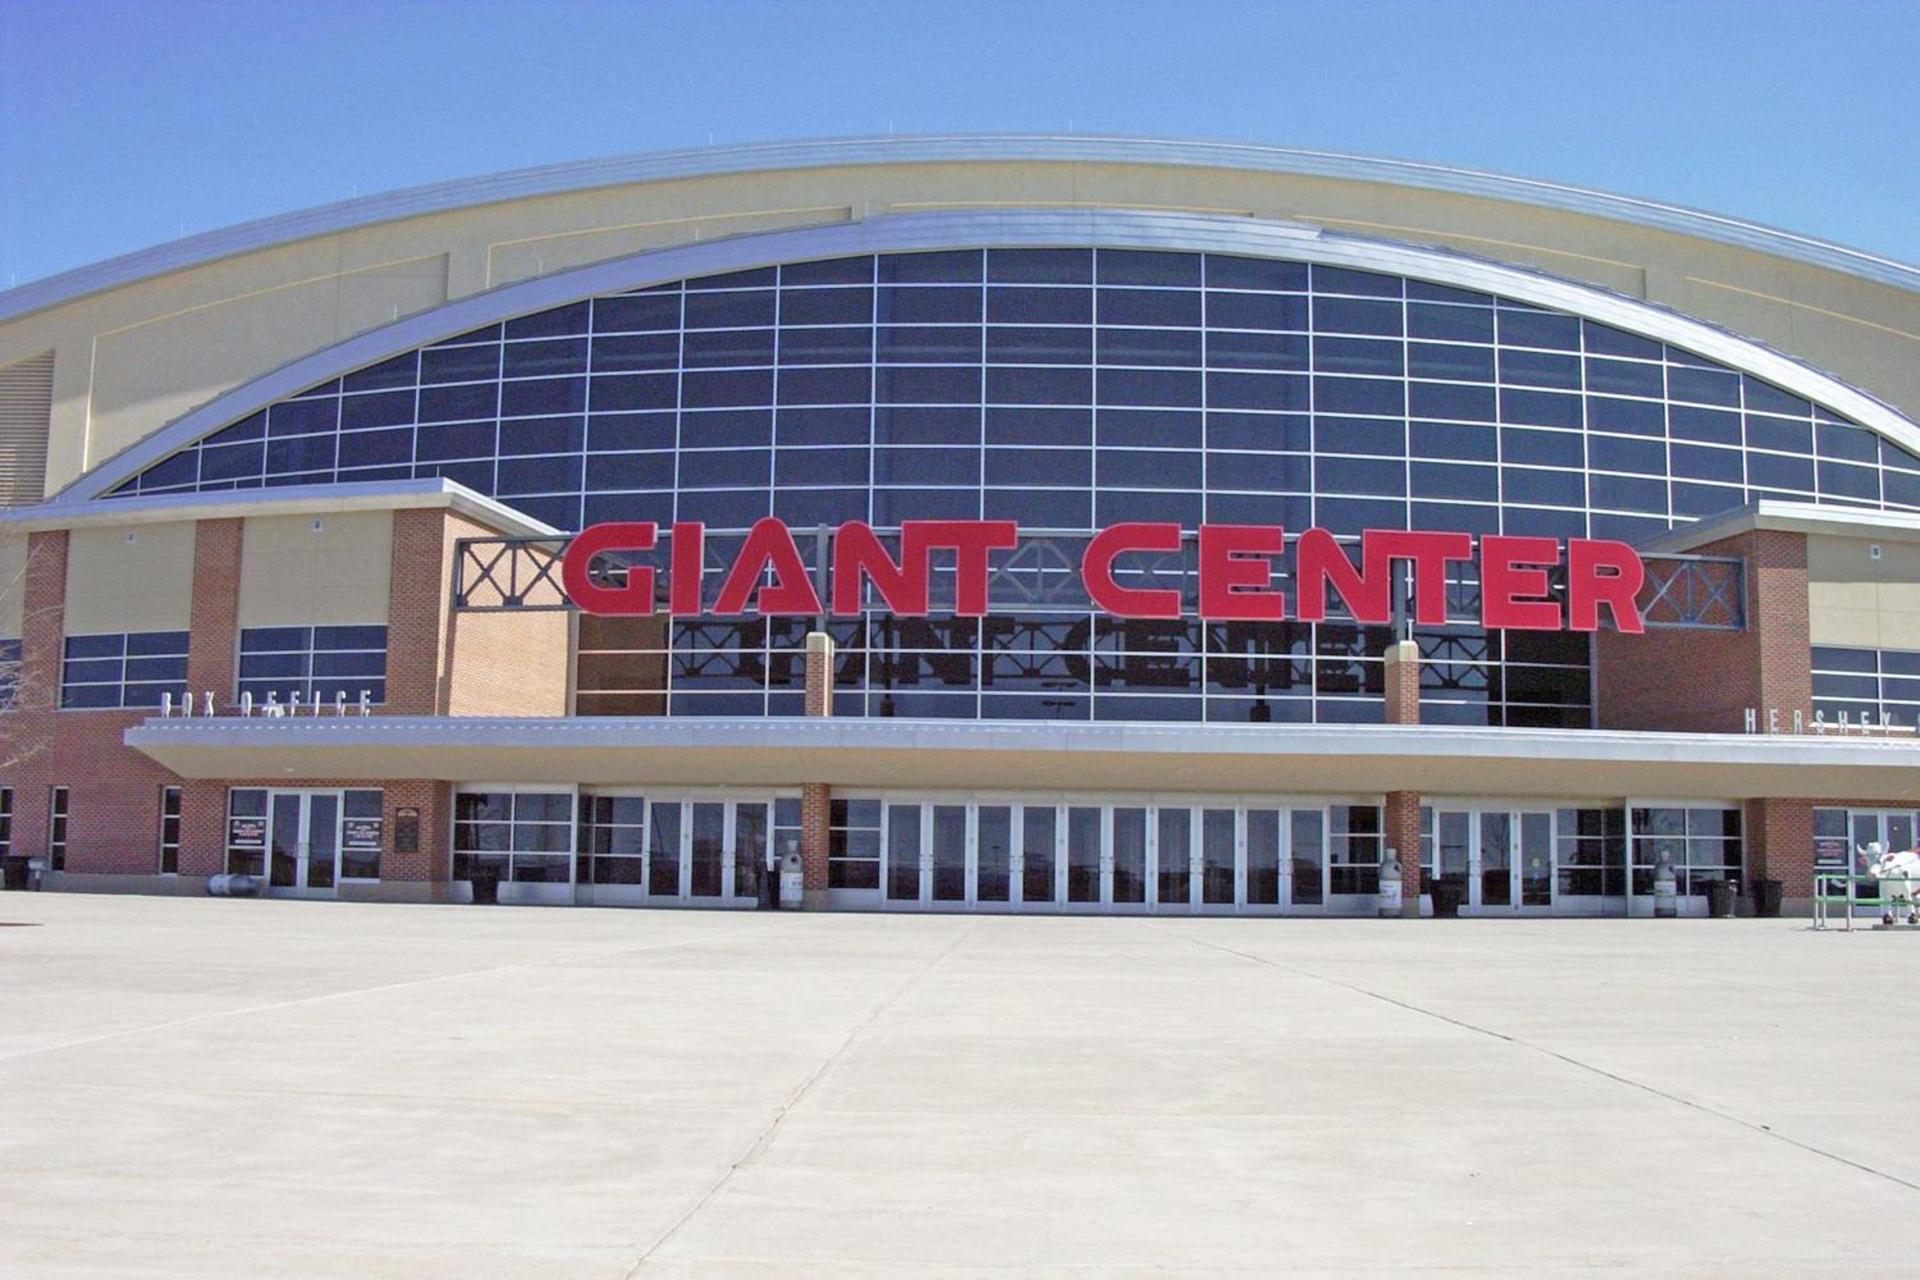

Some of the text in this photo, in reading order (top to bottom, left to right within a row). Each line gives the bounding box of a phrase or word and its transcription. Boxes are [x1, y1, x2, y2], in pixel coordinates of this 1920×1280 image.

[562, 517, 1645, 633] GIANT CENTER
[161, 689, 371, 718] BOX OFFICE
[1745, 708, 1891, 737] HERSHEY
